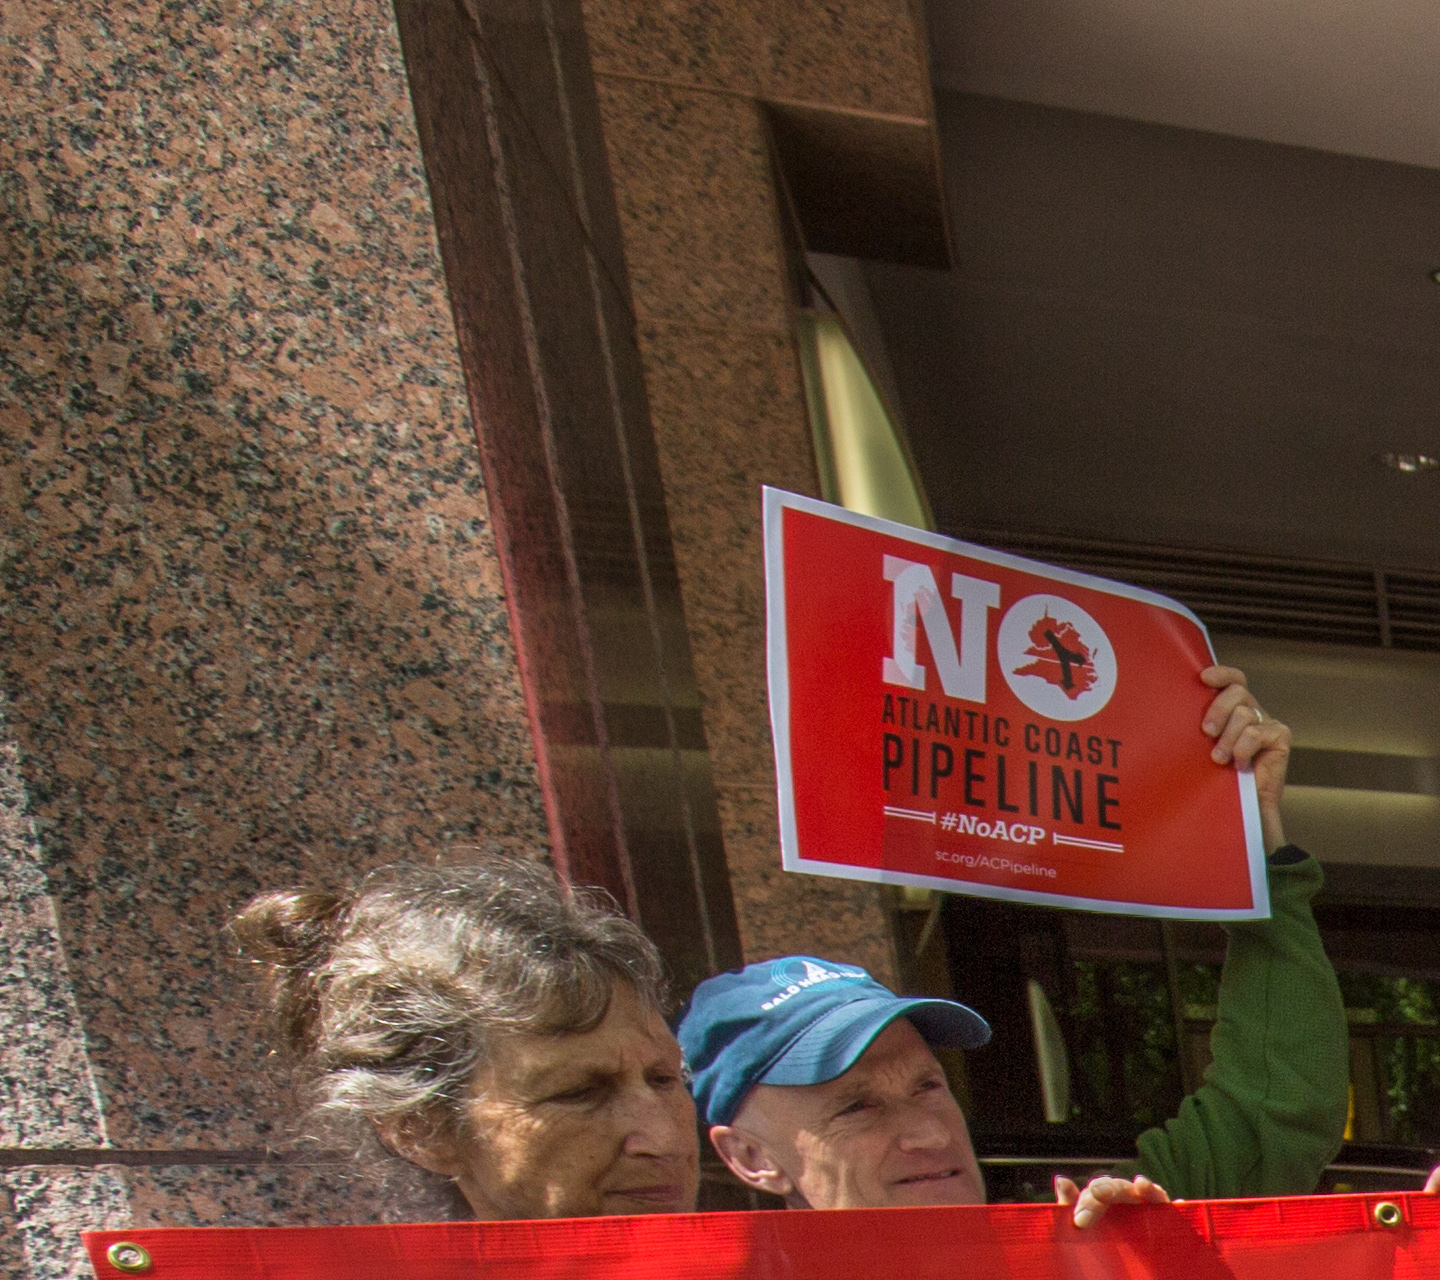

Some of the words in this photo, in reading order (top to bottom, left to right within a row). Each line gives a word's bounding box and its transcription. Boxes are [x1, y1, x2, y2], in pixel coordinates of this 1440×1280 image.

[882, 553, 1117, 722] NO
[881, 694, 1010, 748] ATLANTIC
[1024, 723, 1123, 769] COAST
[881, 733, 1122, 830] PIPELINE
[934, 849, 1058, 880] sc.org/ACPipeline
[940, 811, 1046, 846] #NoACP
